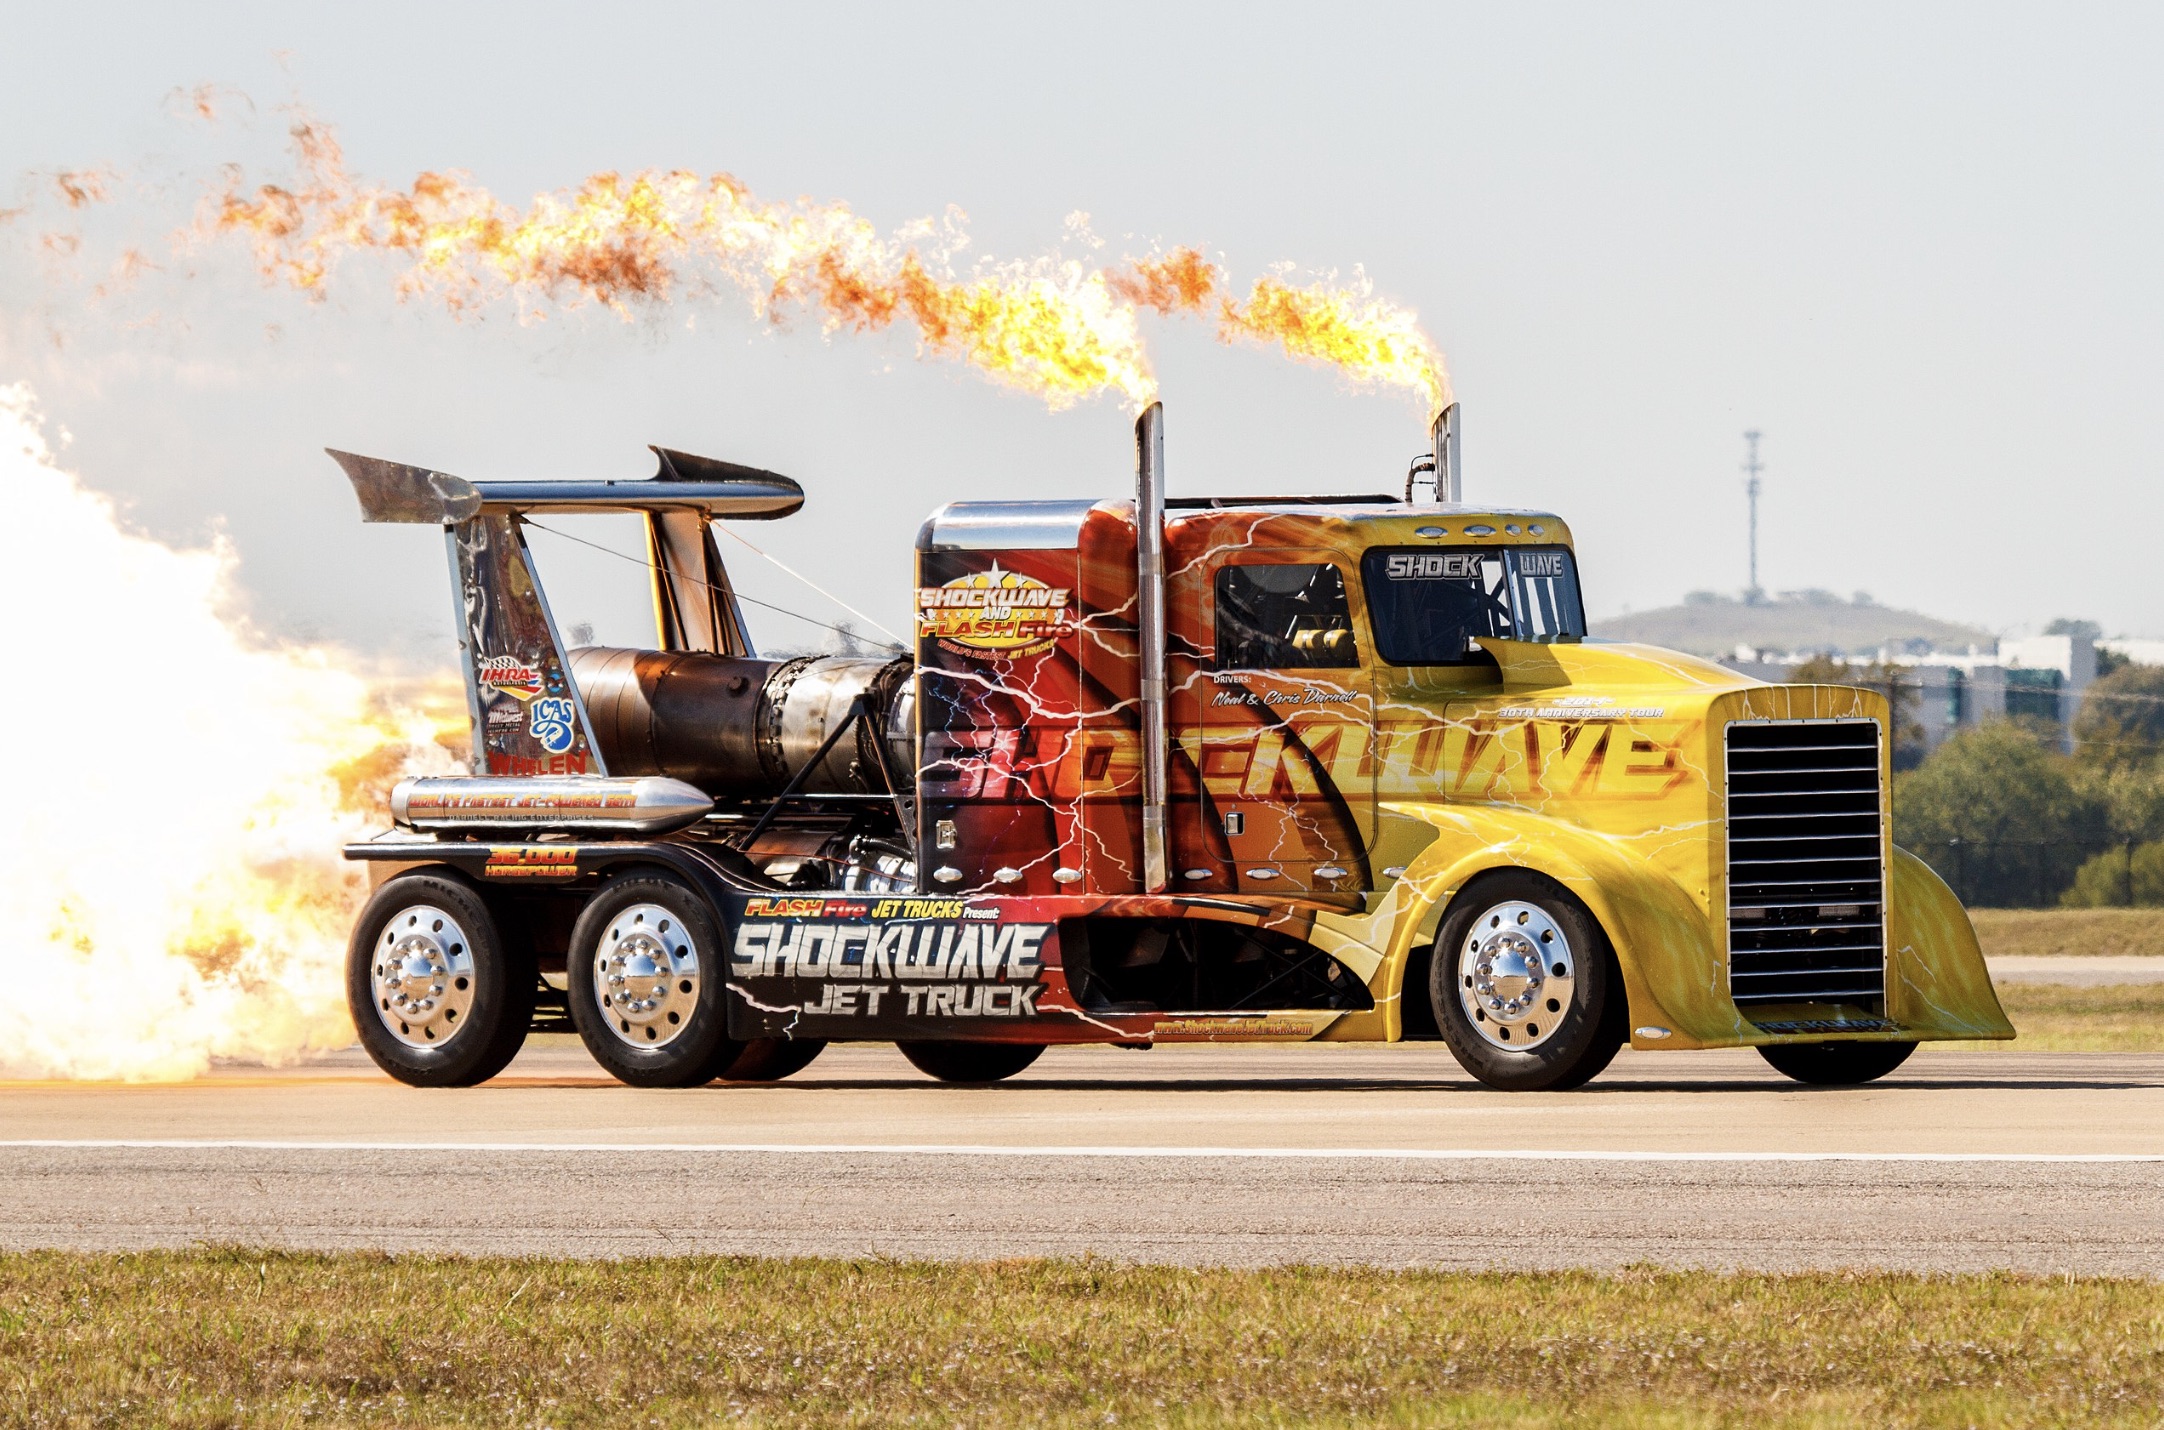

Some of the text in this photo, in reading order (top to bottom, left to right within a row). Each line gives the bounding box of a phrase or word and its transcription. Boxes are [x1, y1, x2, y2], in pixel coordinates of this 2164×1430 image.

[1387, 553, 1563, 579] SHOCK WAVE
[920, 588, 1070, 607] SHOCKWAVE
[980, 606, 1011, 620] AND
[920, 620, 1073, 638] FLASH Fire
[937, 639, 1055, 660] WORLD'S FASTEST JET TRUCKS
[481, 668, 530, 681] IHRA
[1213, 675, 1251, 684] DRIVERS:
[1211, 687, 1358, 708] Neal & Chris Darnell
[488, 711, 524, 723] Midwest
[532, 700, 573, 723] ICAS
[1498, 708, 1665, 718] 30TH ANNIVERSARY TOUR
[487, 749, 591, 776] WHELEN
[408, 794, 638, 808] WORLD'S FASTEST JET-POWERED SEMI
[449, 814, 594, 822] DARNELL RACING ENTERPRISES
[485, 847, 578, 865] 36,000
[485, 866, 578, 877] HORSEPOWER
[744, 899, 1000, 919] FLASH Fire JET TRUCKS Present:
[731, 923, 1050, 979] SHOCKWAVE
[804, 984, 1045, 1016] JET TRUCK
[1154, 1020, 1313, 1035] www.ShockwaveJetTruck.com
